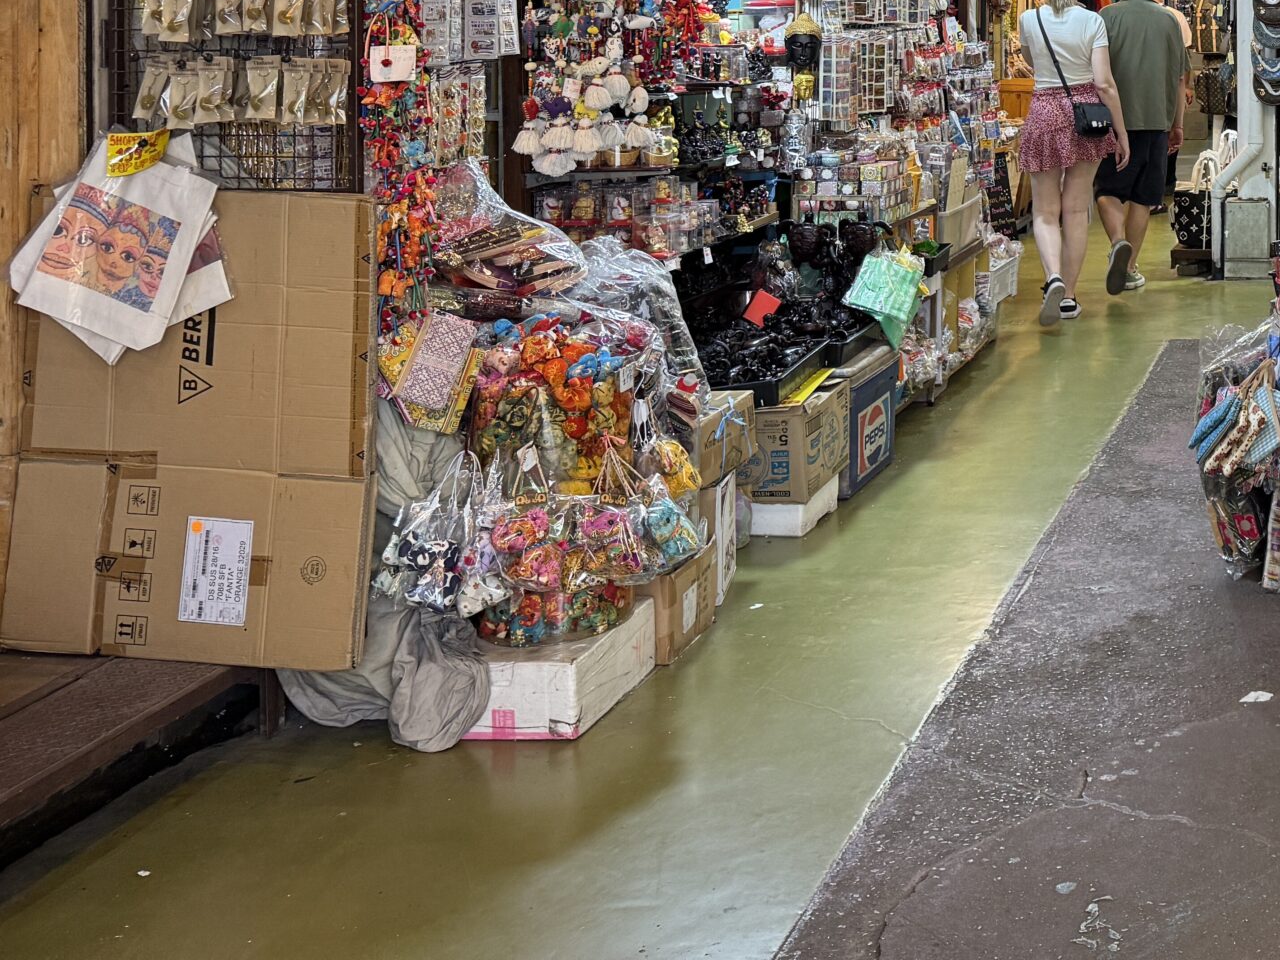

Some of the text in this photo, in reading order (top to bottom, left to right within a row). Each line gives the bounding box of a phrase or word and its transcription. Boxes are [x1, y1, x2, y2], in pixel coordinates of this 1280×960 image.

[182, 312, 202, 363] BER
[183, 379, 197, 391] B
[779, 434, 789, 447] 5
[208, 546, 220, 601] DS SUS 28/16
[218, 564, 227, 581] SFB
[234, 540, 247, 603] ORANGE 32029
